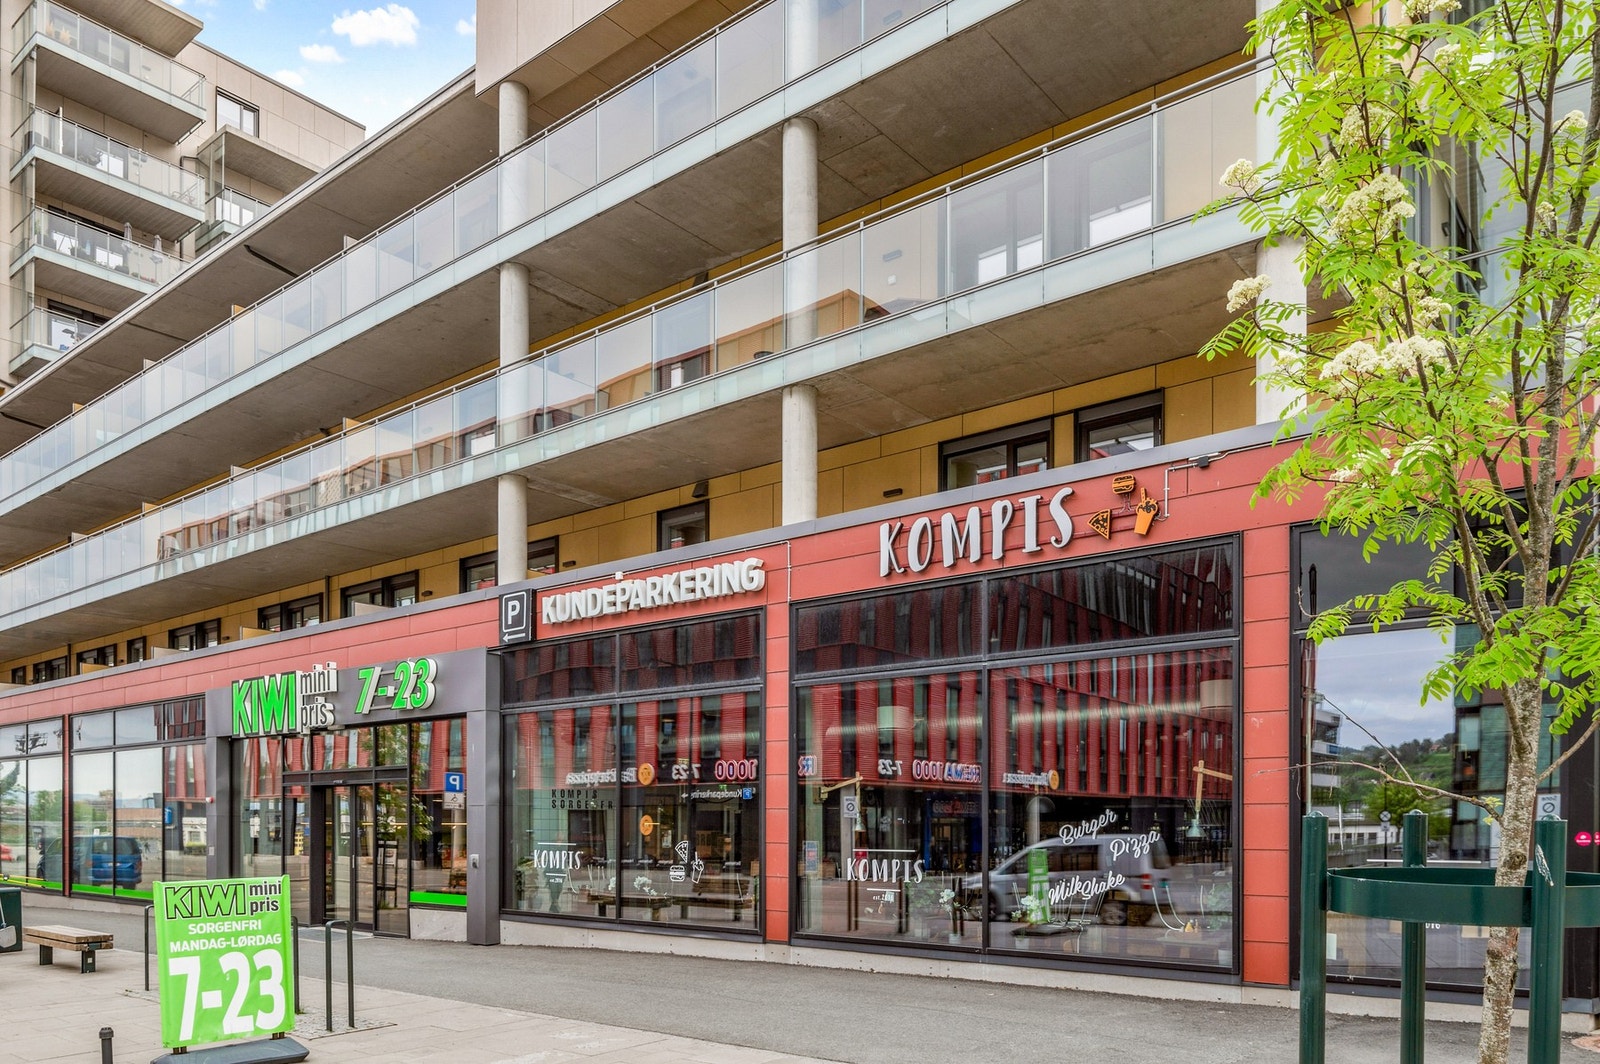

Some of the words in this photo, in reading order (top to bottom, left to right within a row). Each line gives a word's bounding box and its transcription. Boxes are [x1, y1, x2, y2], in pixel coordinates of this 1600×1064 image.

[879, 487, 1074, 577] KOMPIS
[541, 558, 766, 624] KUNDEPARKERING
[507, 600, 520, 624] P
[300, 661, 337, 696] mini
[355, 657, 437, 714] 7-23
[232, 671, 297, 736] KIWI
[300, 696, 335, 734] pris
[551, 789, 598, 799] KOMPIS
[1059, 809, 1118, 846] Burger
[533, 849, 583, 870] KOMPIS
[1110, 830, 1161, 862] Pizza
[846, 857, 925, 884] KOMPIS
[165, 884, 246, 919] KIWI
[250, 881, 282, 896] mini
[250, 897, 279, 916] pris
[169, 933, 282, 953] MANDAG-LØRDAG
[188, 919, 262, 935] SORGENFRI
[168, 948, 286, 1042] 7-23
